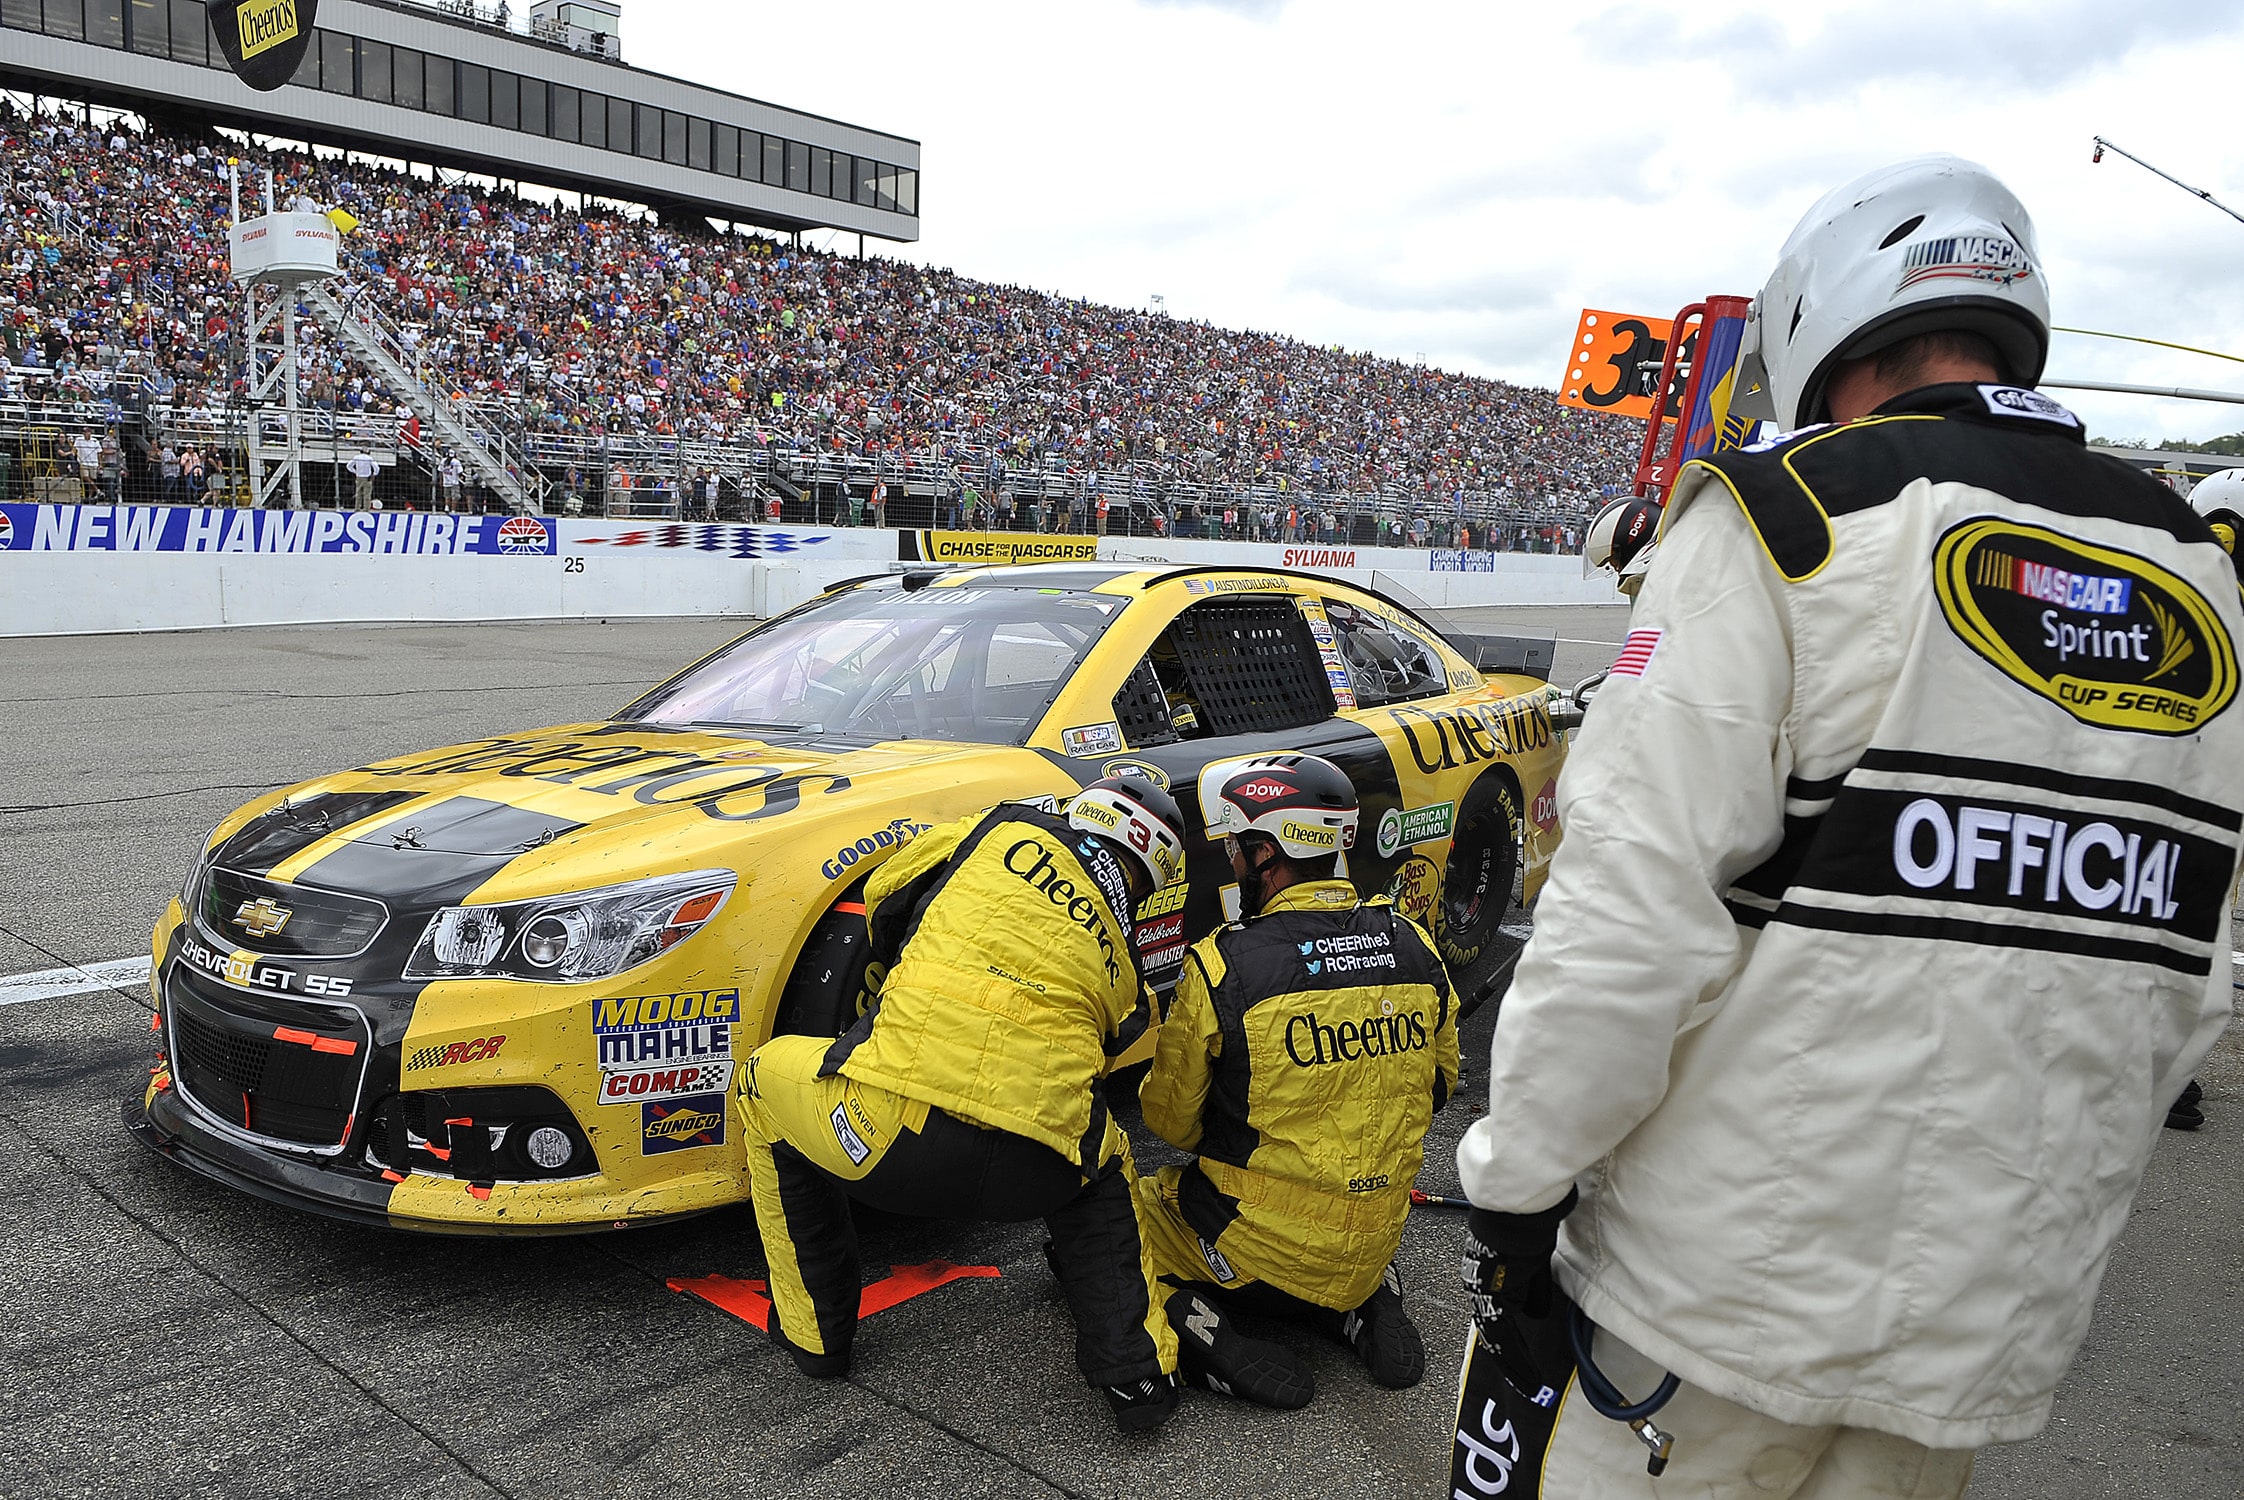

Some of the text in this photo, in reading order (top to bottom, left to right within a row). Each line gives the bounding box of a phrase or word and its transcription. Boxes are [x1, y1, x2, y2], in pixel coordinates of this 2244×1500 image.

[242, 0, 294, 48] Cheerios
[31, 504, 484, 555] NEW HAMPSHIRE
[1629, 512, 1646, 537] DOW
[939, 542, 995, 556] CHASE
[1010, 543, 1073, 557] NASCAR
[1282, 549, 1355, 567] SYLVANIA
[564, 557, 585, 574] 25
[875, 591, 991, 605] DILLON
[2023, 561, 2126, 613] NASCAR
[2041, 609, 2150, 662] Sprint
[2058, 681, 2199, 723] CUP SERIES
[1084, 727, 1110, 742] NASCAR
[1388, 695, 1549, 774] Cheerios
[1070, 741, 1116, 754] RACE CAR
[1245, 783, 1285, 796] DOW
[1076, 800, 1117, 827] Cheerios
[1403, 807, 1449, 827] AMERICAN
[1499, 788, 1517, 842] EAGLE
[1128, 818, 1151, 853] 3
[1283, 822, 1335, 845] Cheerios
[1342, 825, 1355, 847] 3
[1404, 823, 1446, 841] ETHANOL
[1892, 798, 2181, 920] OFFICIAL
[1404, 863, 1426, 881] Bass
[1403, 880, 1420, 897] Pro
[1136, 883, 1190, 921] JEGS
[1405, 894, 1431, 915] Shops
[1136, 920, 1181, 947] Edelbrock
[1315, 932, 1390, 955] CHEERthe3
[181, 939, 353, 997] CHEVROLET SS
[1325, 950, 1396, 973] RCRracing
[986, 964, 1047, 994] sparco
[595, 989, 736, 1028] MOOG
[441, 1035, 507, 1066] RCR
[599, 1024, 729, 1064] MAHLE
[1284, 1011, 1427, 1068] Cheerios
[665, 1052, 730, 1065] ENGINE BEARINGS
[606, 1068, 700, 1097] COMP
[671, 1082, 716, 1095] CAMS
[647, 1114, 721, 1137] SUNOCO
[850, 1098, 877, 1137] CRAVEN
